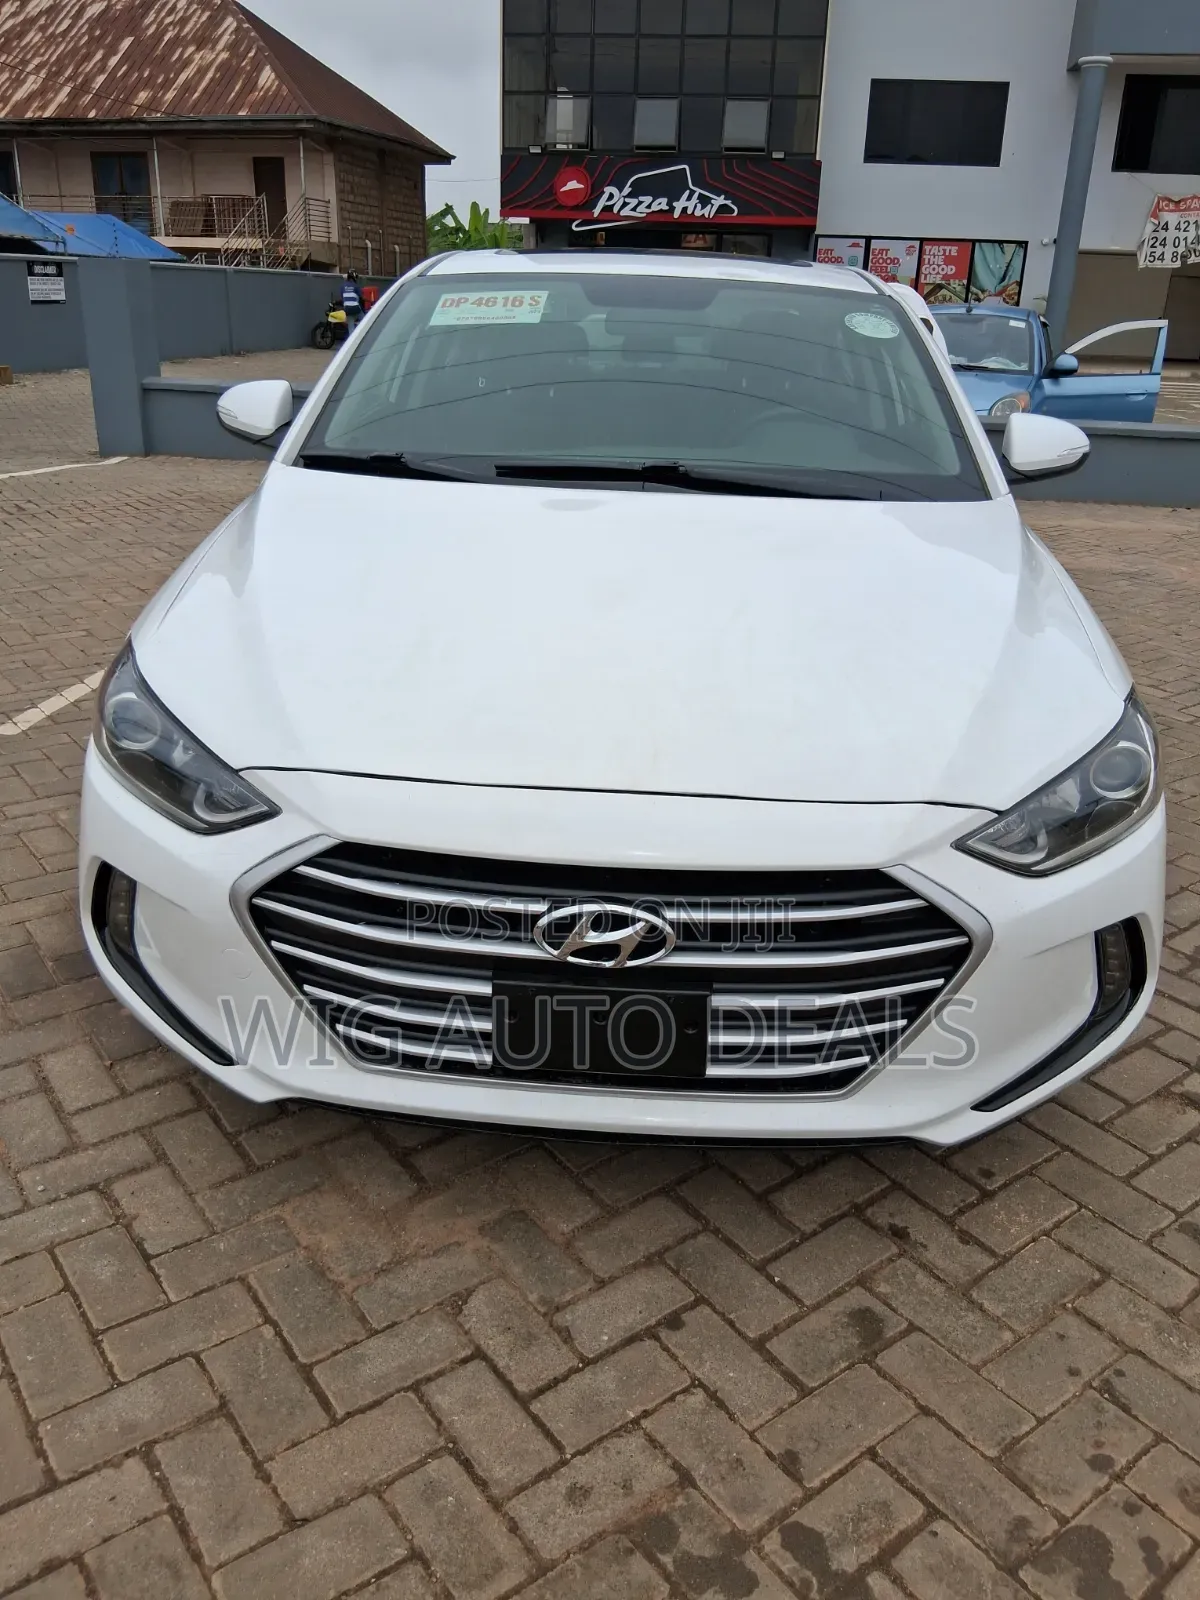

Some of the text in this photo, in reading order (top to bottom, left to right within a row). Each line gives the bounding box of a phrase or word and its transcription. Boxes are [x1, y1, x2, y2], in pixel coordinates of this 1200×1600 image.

[592, 185, 738, 218] Pizza Hut
[818, 248, 834, 256] EAT
[871, 248, 890, 257] EAT
[924, 245, 958, 256] TASTE
[923, 255, 944, 265] THE
[921, 265, 956, 275] GOOD
[440, 297, 470, 309] DP
[528, 295, 542, 307] S
